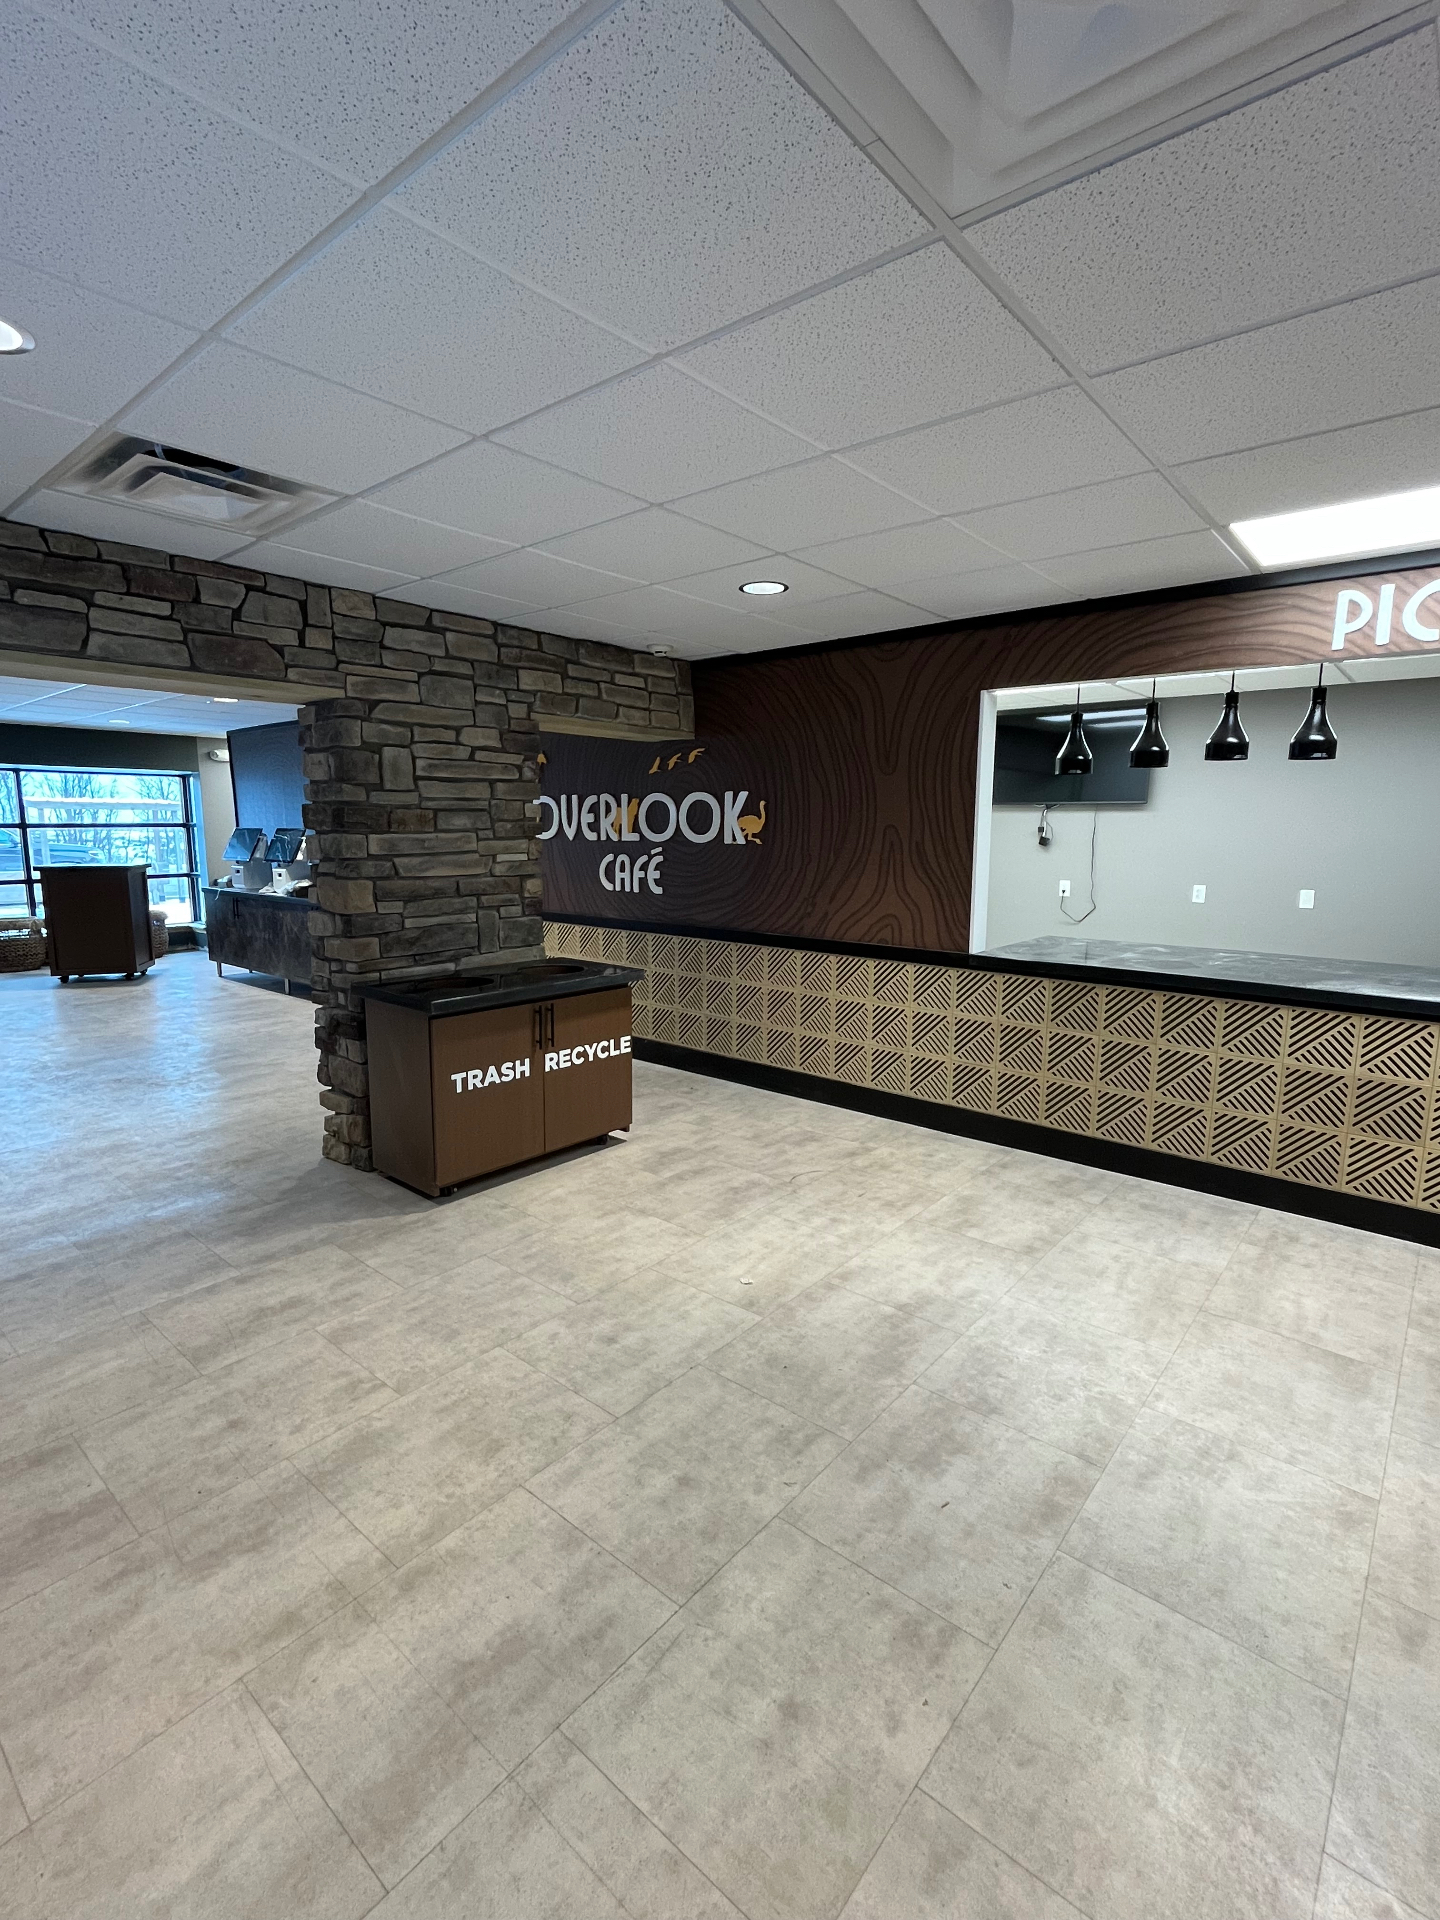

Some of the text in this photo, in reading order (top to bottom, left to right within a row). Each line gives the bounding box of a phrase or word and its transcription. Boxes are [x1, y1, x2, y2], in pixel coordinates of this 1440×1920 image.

[1331, 578, 1440, 651] PIC
[599, 846, 663, 895] CAFÉ
[450, 1035, 632, 1094] TRASH RECYCLE
